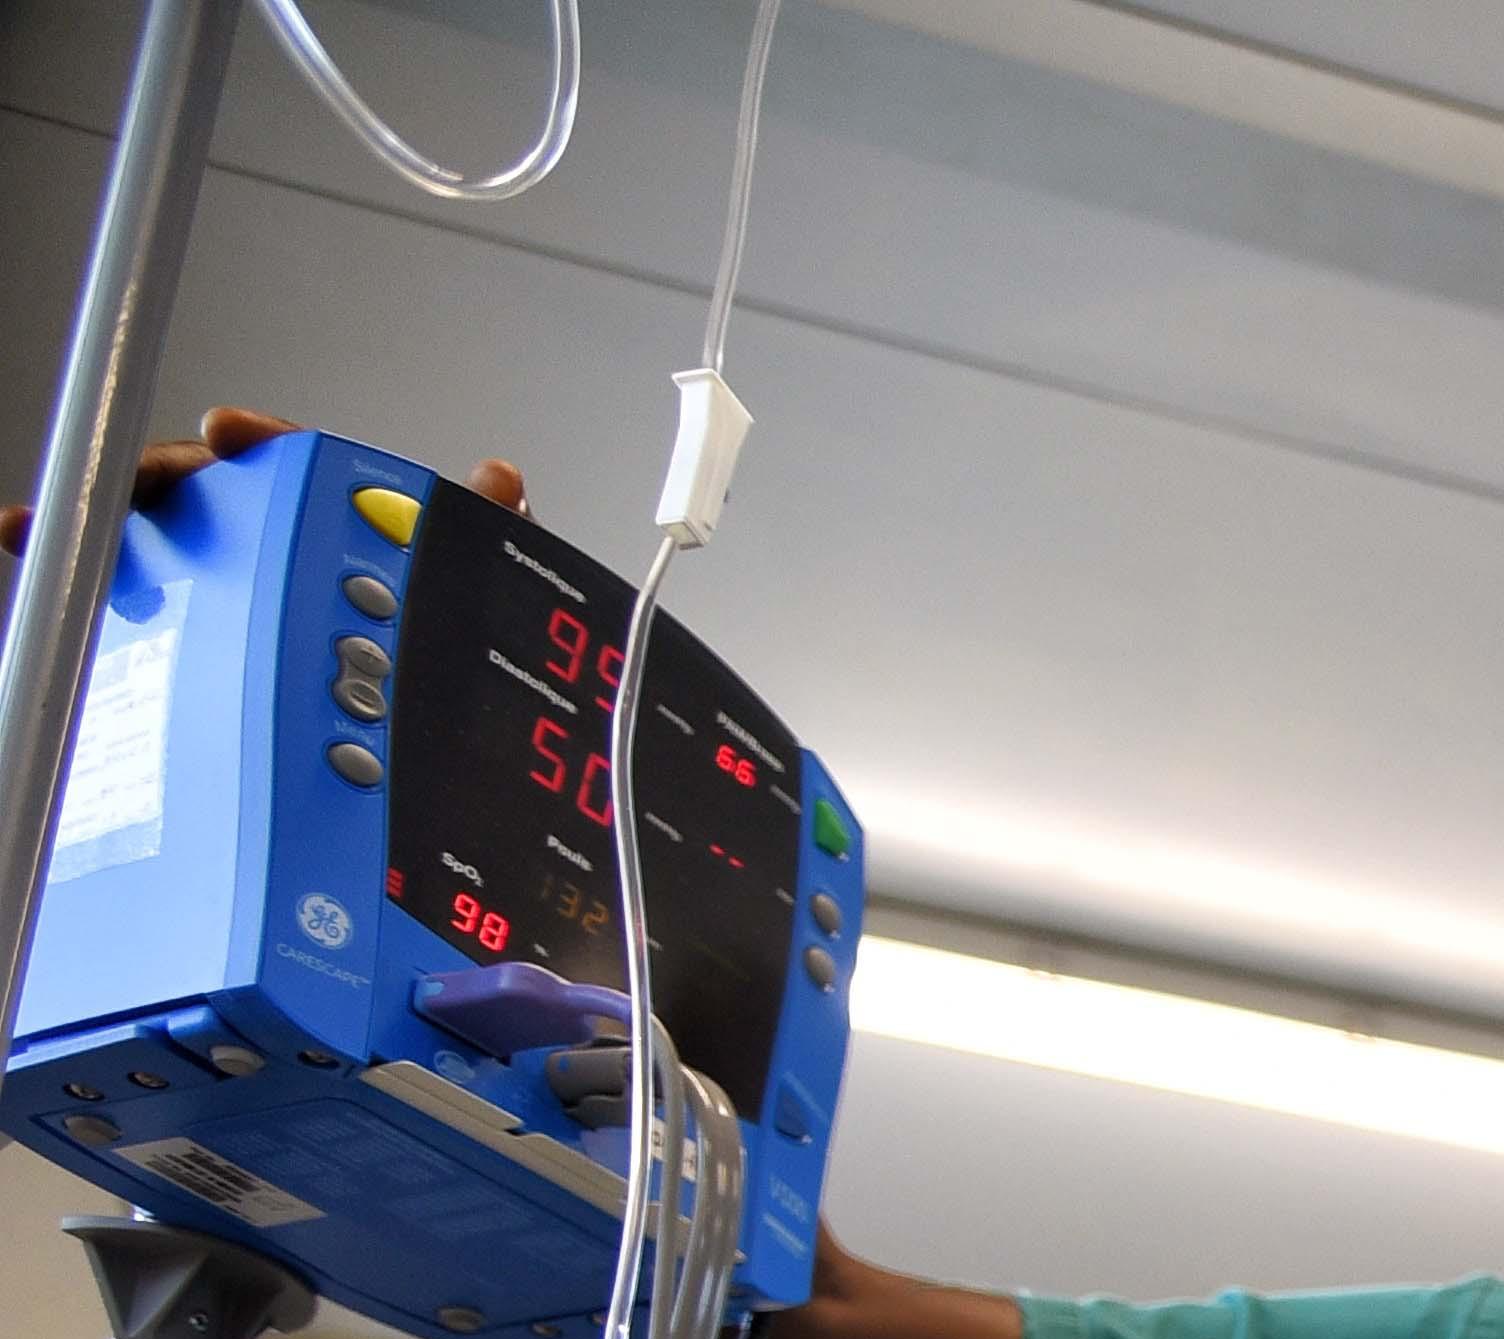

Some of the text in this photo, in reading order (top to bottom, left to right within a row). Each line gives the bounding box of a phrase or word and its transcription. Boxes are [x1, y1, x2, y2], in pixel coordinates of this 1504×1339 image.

[504, 540, 587, 604] Systolique
[488, 649, 578, 714] Diastolique
[529, 715, 615, 827] 50
[716, 744, 757, 788] 66
[450, 891, 511, 953] 98
